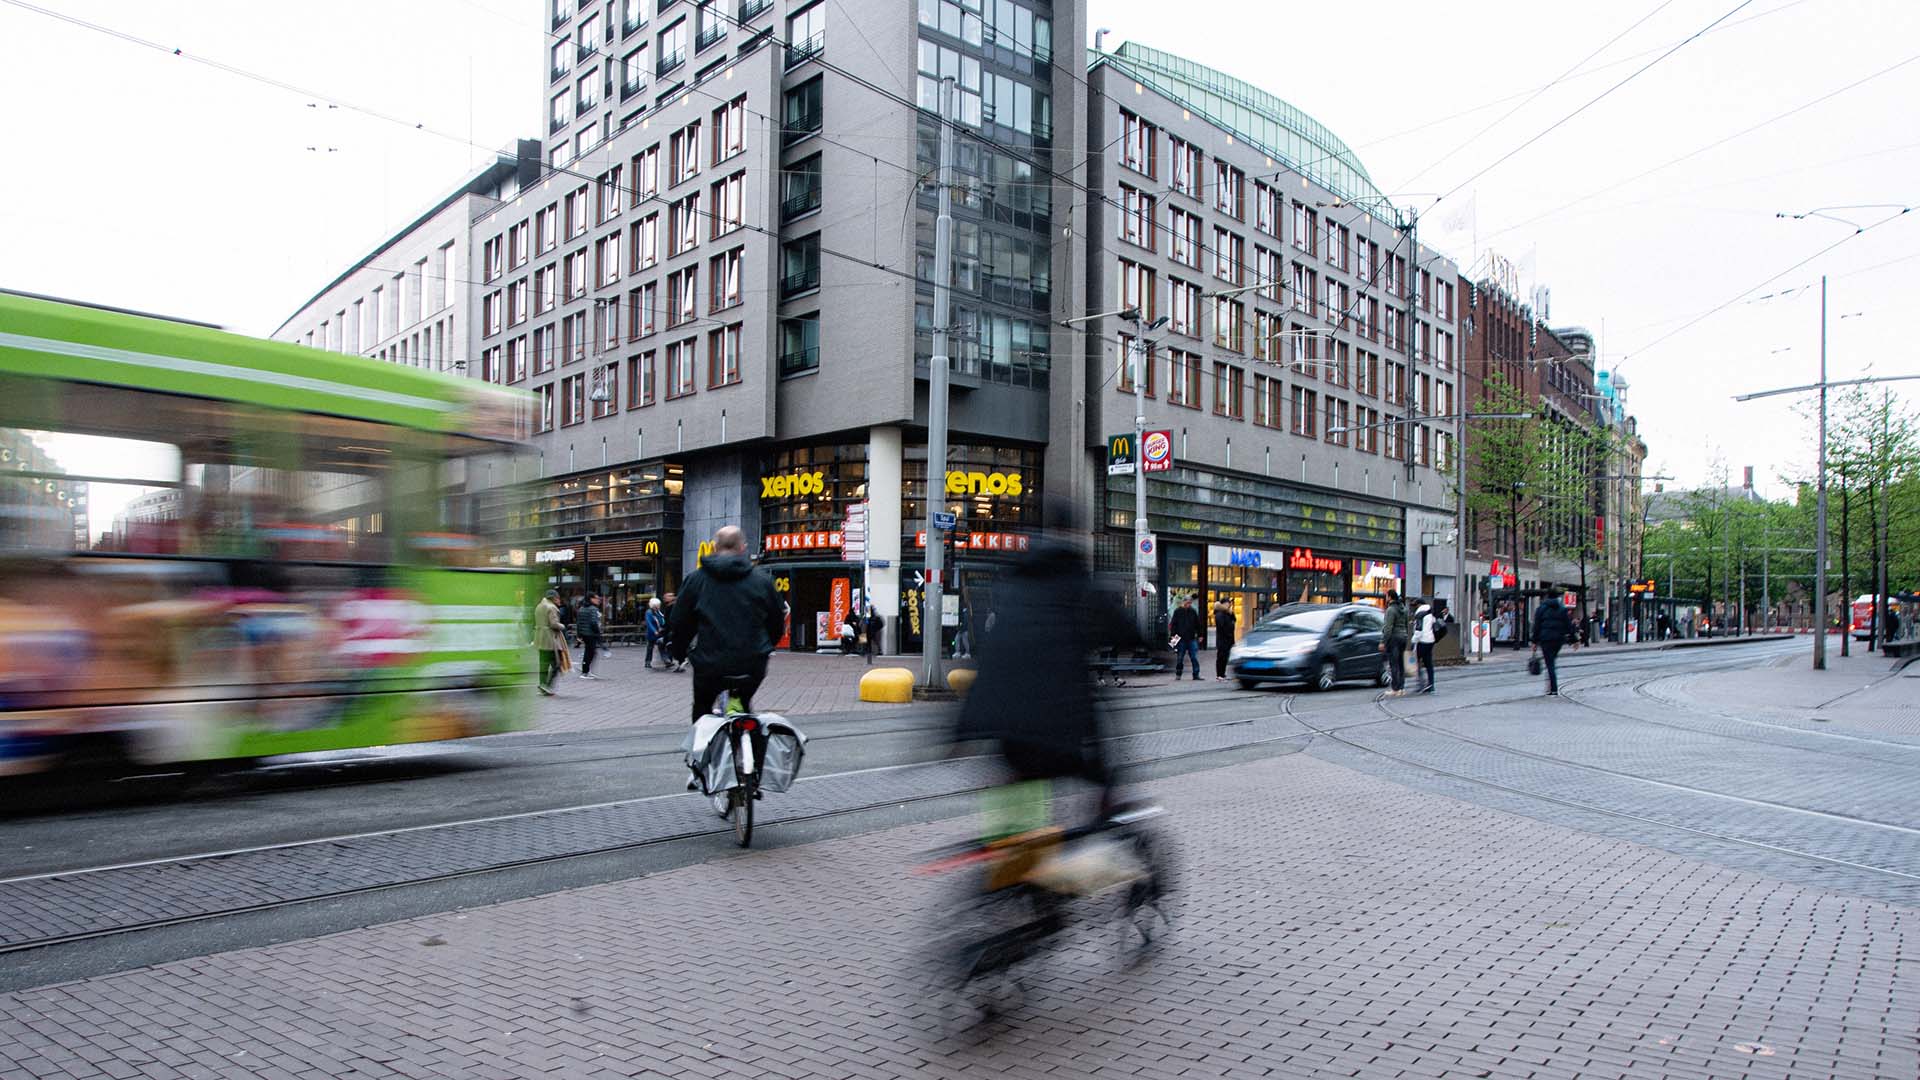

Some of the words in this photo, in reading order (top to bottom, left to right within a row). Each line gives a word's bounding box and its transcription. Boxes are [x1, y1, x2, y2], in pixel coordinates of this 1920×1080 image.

[1148, 442, 1166, 453] KING
[761, 471, 824, 498] xenos
[766, 532, 841, 549] BLOKKER
